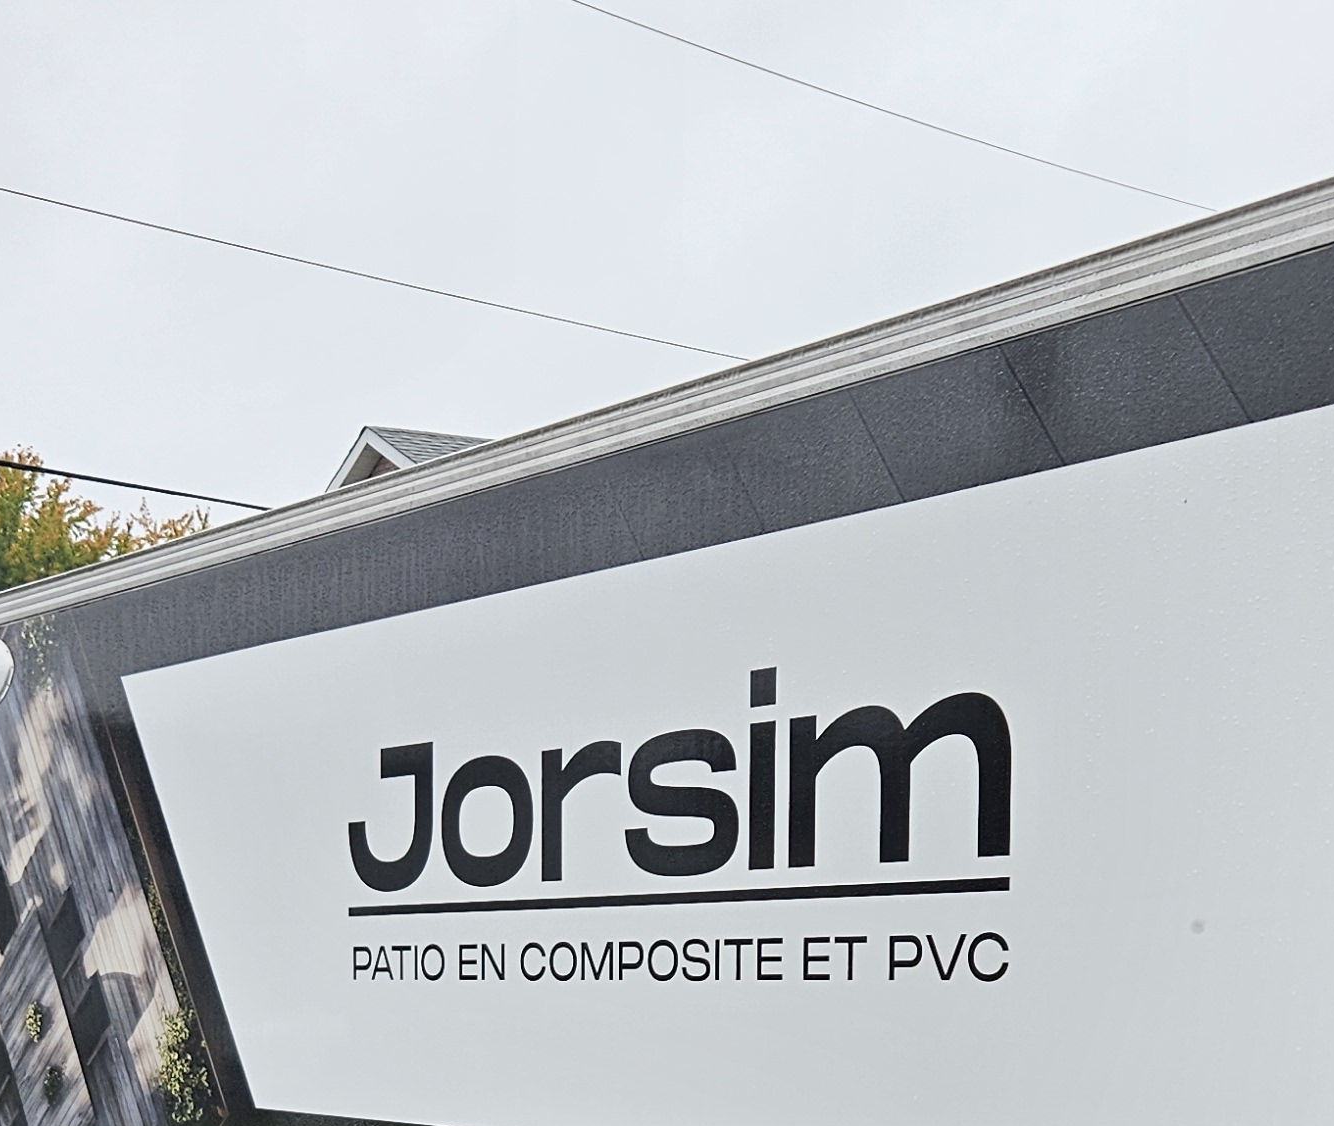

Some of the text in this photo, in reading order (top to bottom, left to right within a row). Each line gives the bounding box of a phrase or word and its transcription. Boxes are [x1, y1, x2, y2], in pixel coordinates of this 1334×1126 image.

[348, 666, 1011, 892] Jorsim
[353, 931, 1010, 983] PATIO EN COMPOSITE ET PVC
